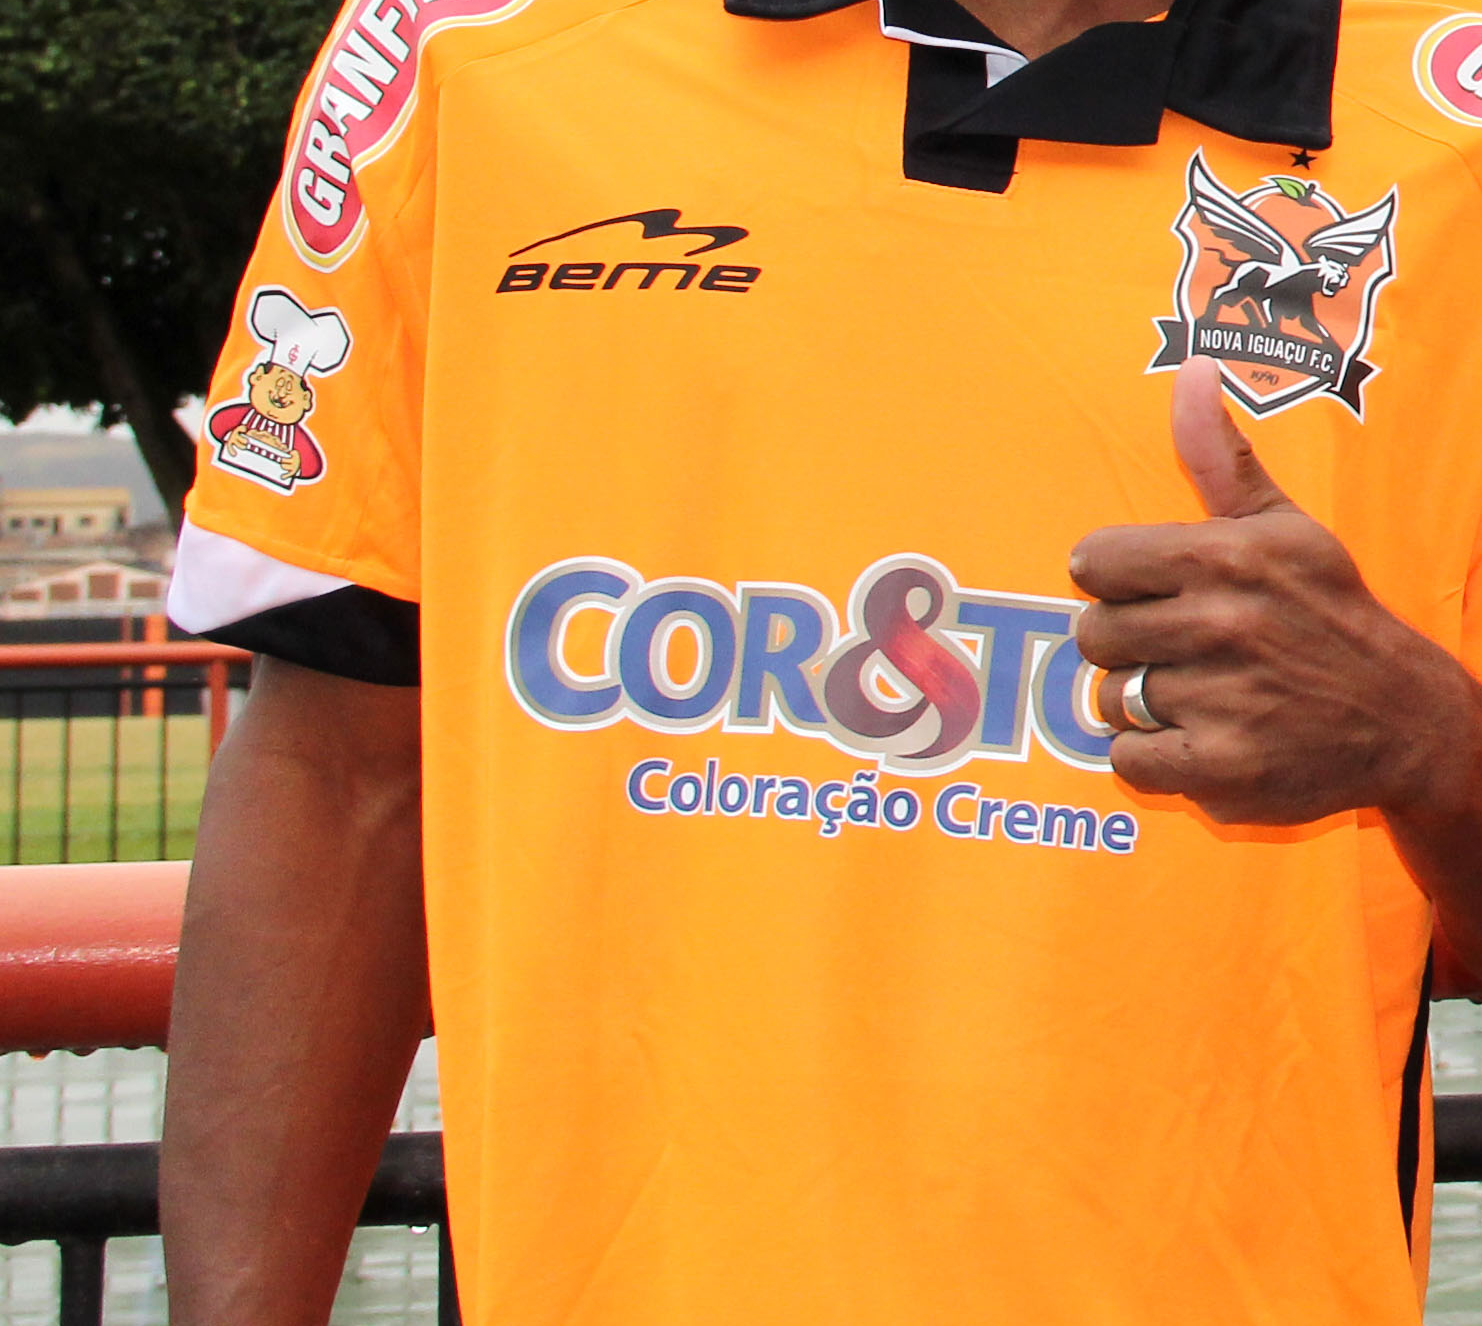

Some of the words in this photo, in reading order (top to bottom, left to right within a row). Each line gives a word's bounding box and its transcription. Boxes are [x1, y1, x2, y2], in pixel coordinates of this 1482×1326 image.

[1199, 329, 1242, 352] NOVA
[1247, 333, 1307, 364] IGUAÇU
[505, 553, 1117, 776] COR&T
[627, 757, 919, 836] Coloração
[934, 781, 1138, 854] Creme
